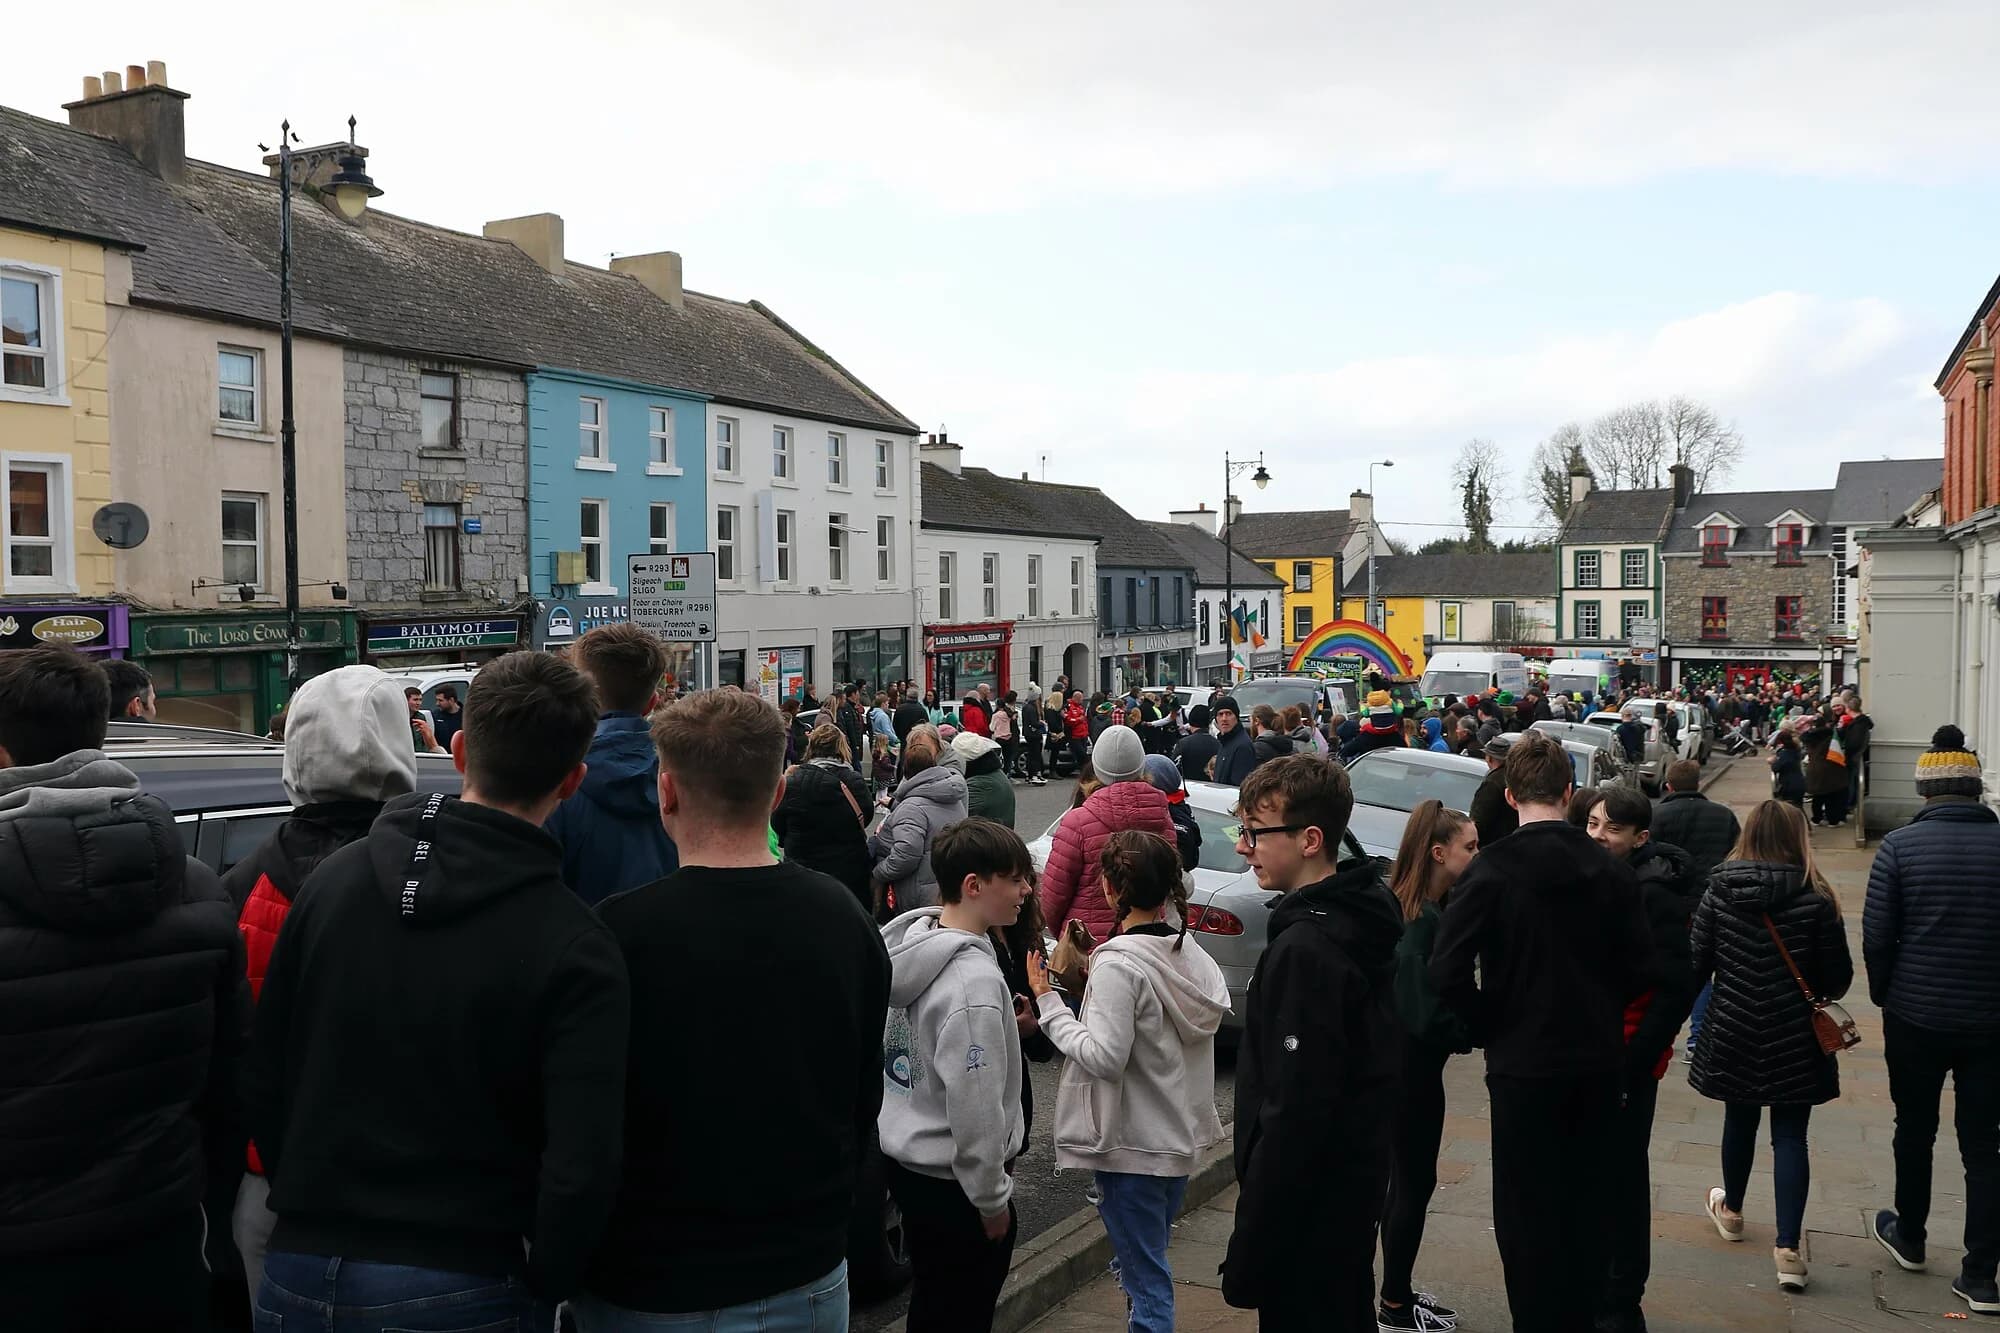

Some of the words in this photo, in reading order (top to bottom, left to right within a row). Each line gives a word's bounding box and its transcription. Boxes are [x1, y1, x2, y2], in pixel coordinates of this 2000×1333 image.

[648, 564, 669, 572] R293
[585, 606, 608, 618] JOE
[633, 608, 684, 616] TOBERCURRY
[52, 618, 88, 627] Hair
[41, 629, 96, 639] Design
[401, 622, 490, 637] BALLYMOTE
[660, 629, 692, 638] STATION
[184, 627, 212, 646] The
[409, 635, 482, 648] PHARMACY
[422, 792, 445, 820] DIESEL
[402, 880, 419, 915] DIESEL
